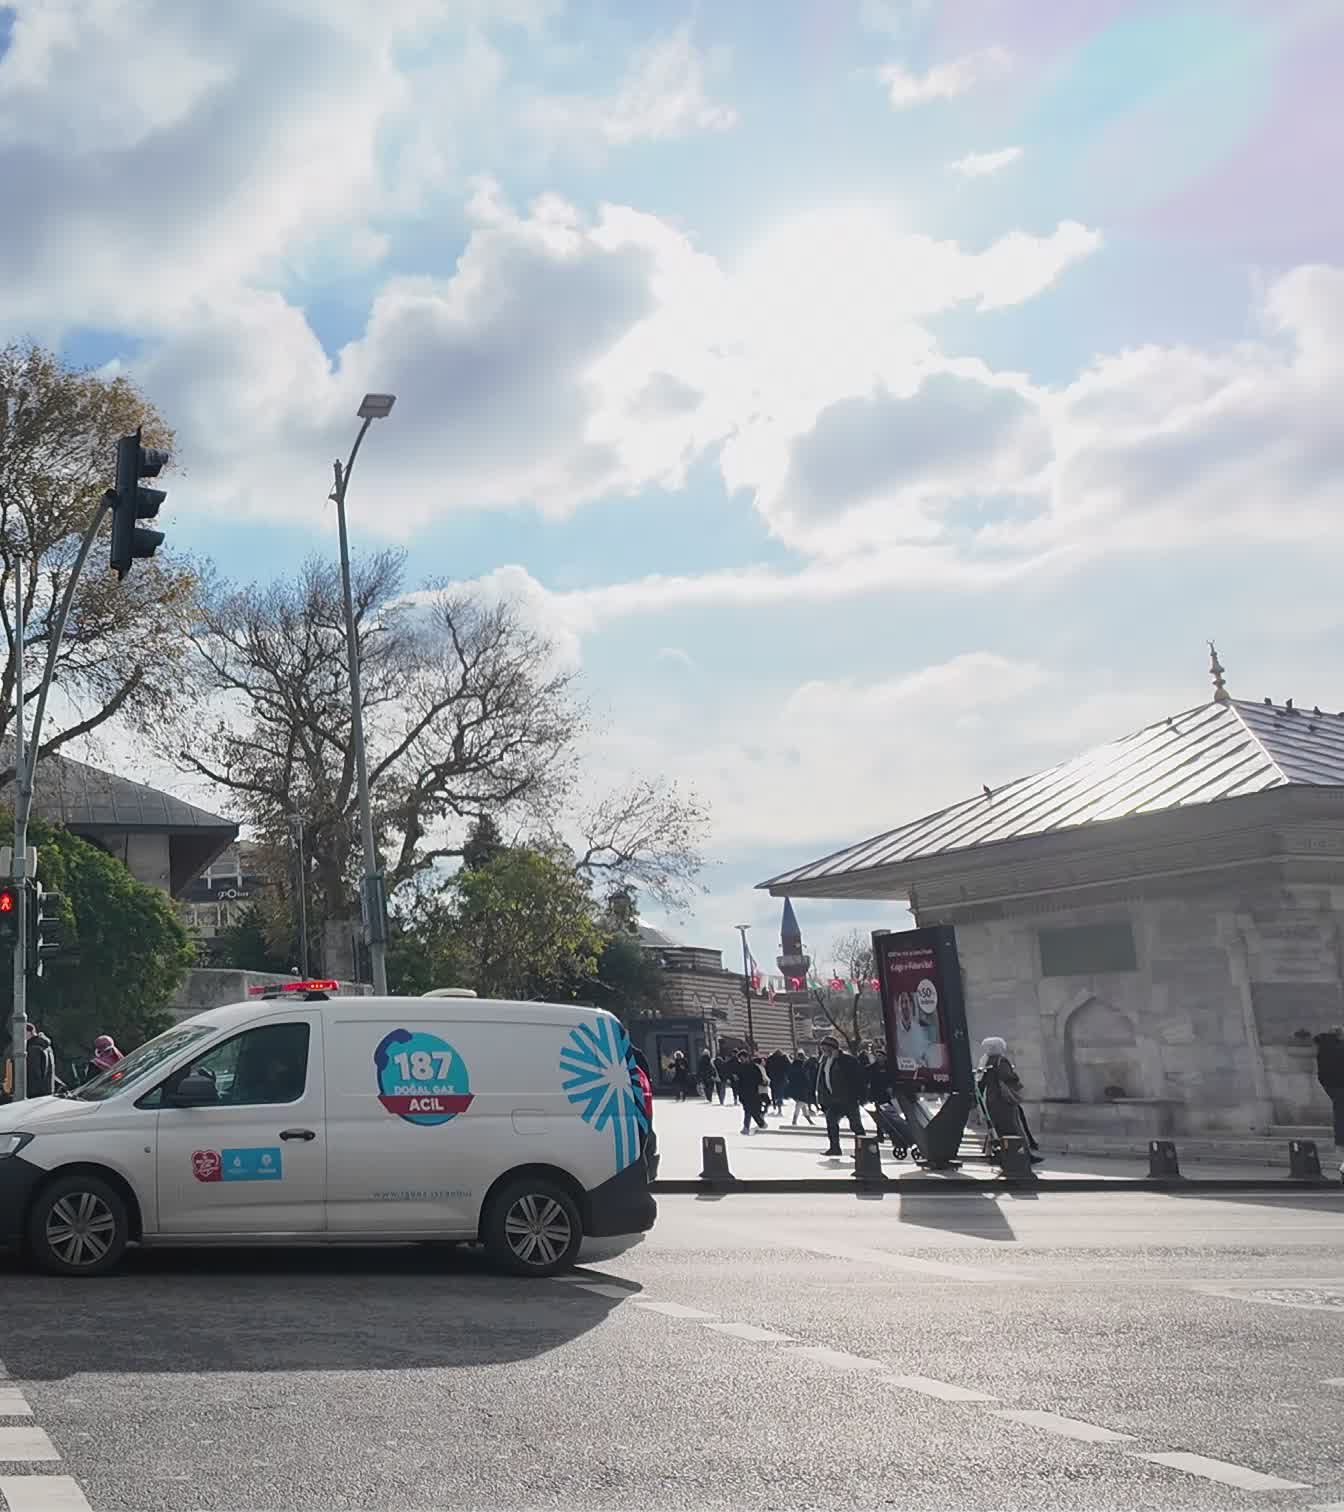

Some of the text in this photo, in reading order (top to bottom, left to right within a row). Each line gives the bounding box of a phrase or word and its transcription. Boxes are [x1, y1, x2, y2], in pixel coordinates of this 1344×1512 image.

[394, 1051, 452, 1080] 187
[394, 1083, 456, 1096] DOĞAL GAZ
